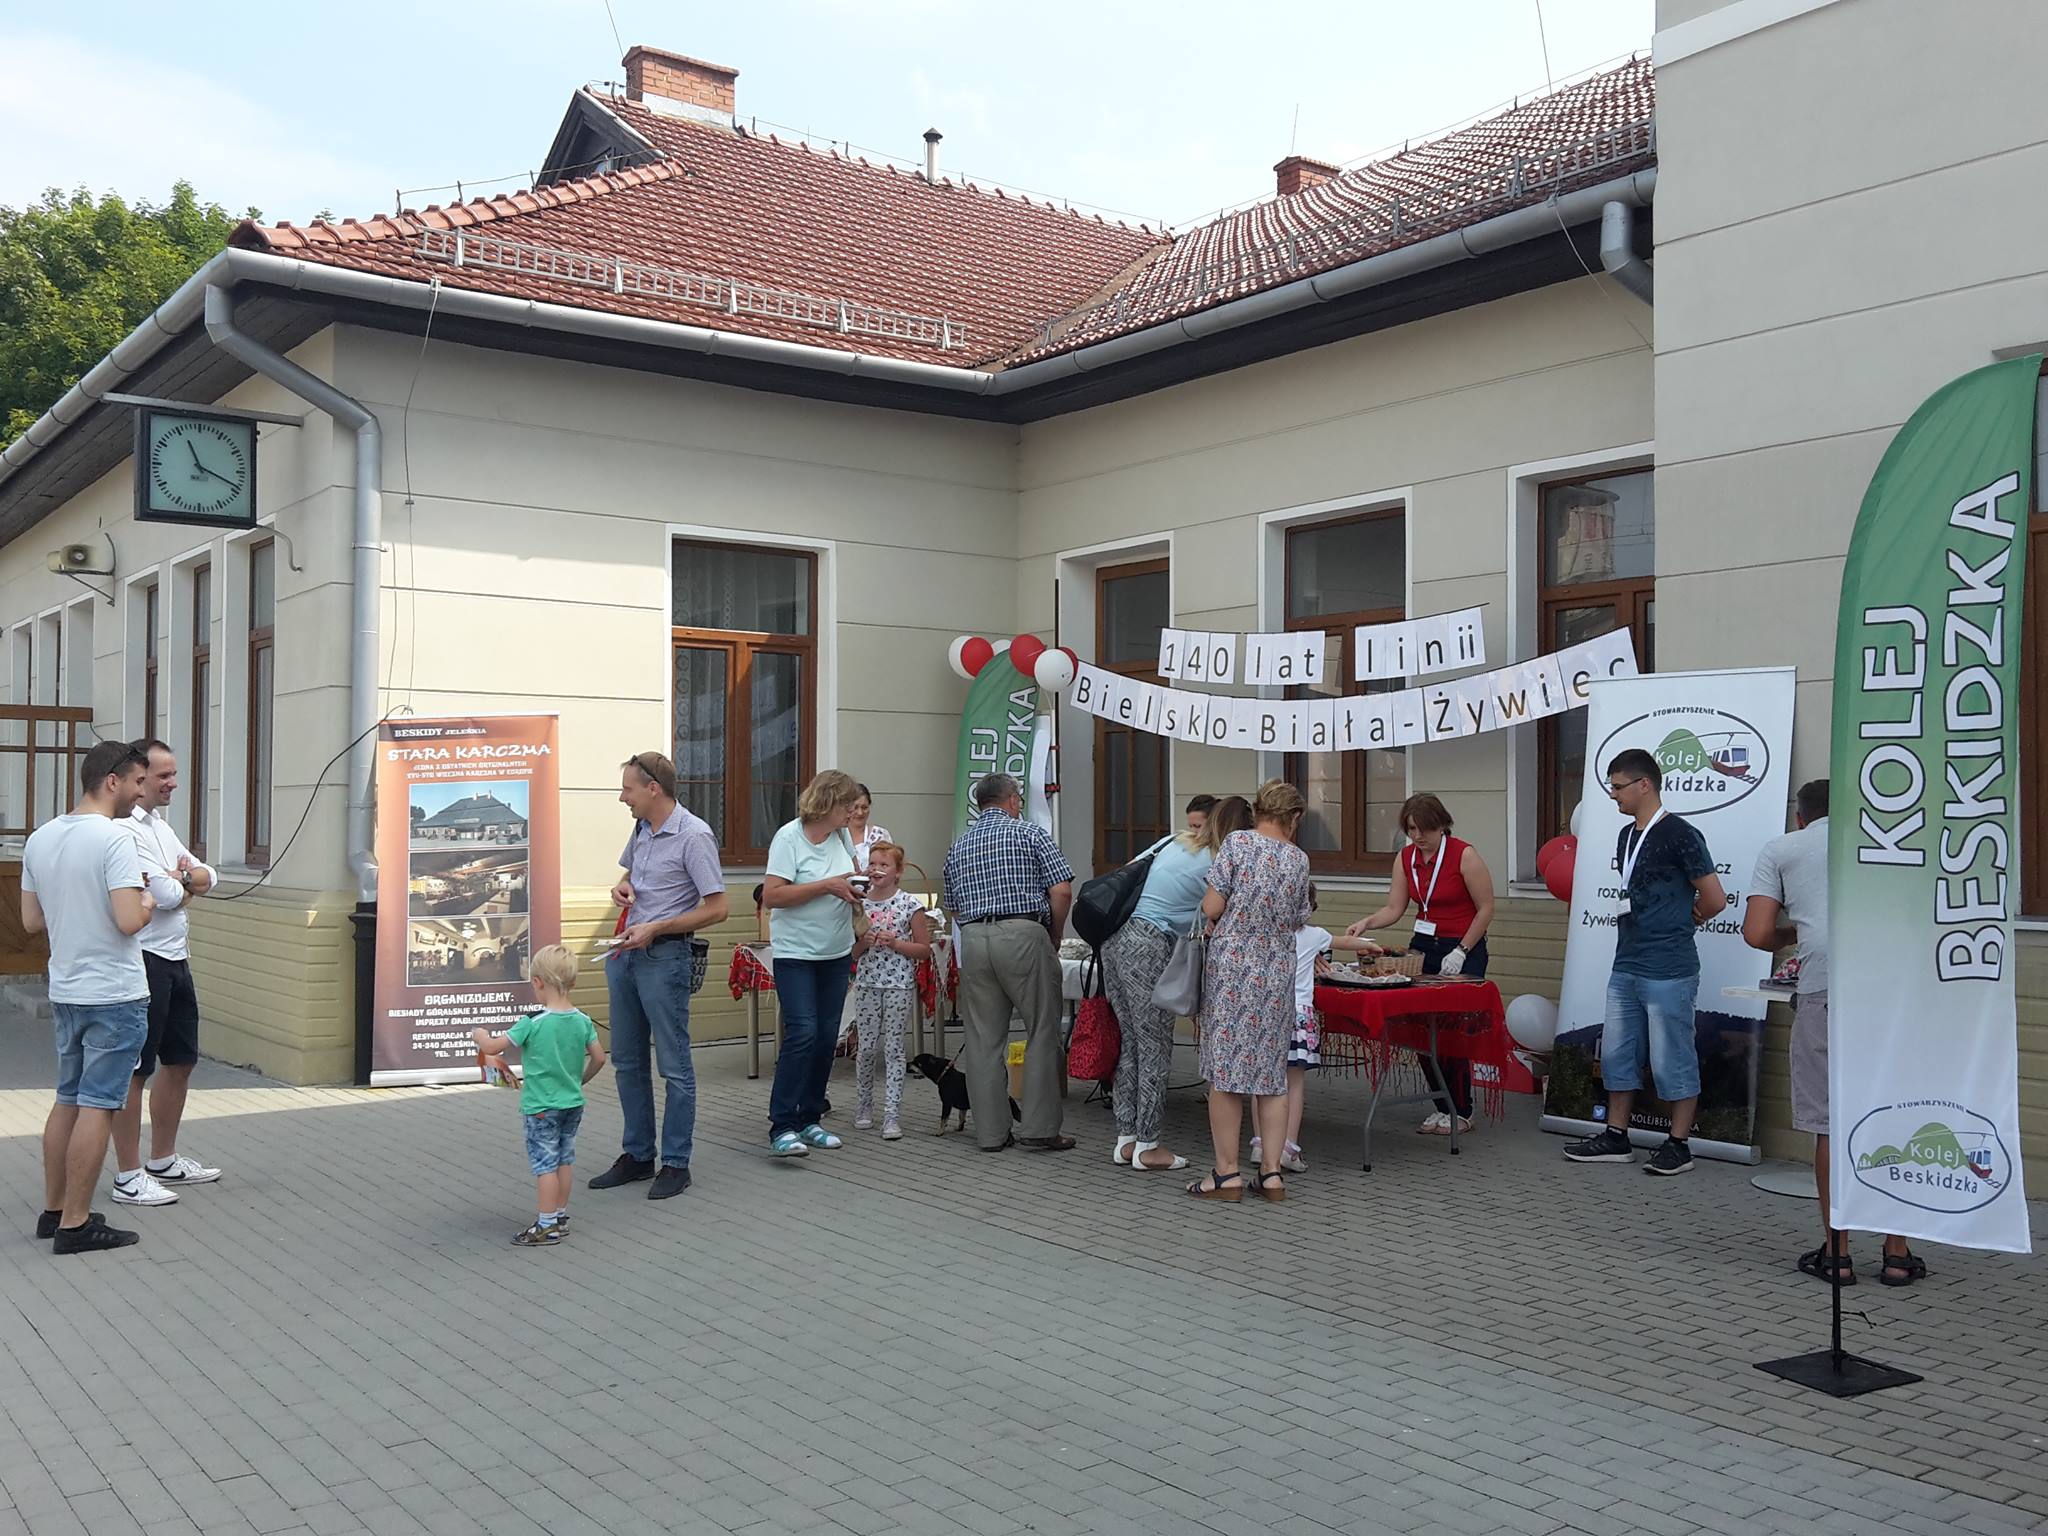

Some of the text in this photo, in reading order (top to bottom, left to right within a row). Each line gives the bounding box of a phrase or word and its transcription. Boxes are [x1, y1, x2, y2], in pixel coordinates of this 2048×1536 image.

[1164, 625, 1475, 678] 140 lat linii
[1652, 706, 1715, 718] STOWARZYSZENIE
[394, 727, 443, 738] BESKIDY
[1858, 470, 2020, 982] KOLEJ BESKIDZKA
[387, 744, 552, 761] STARA KARCZMA
[1655, 750, 1702, 769] Kolej
[1664, 776, 1727, 792] kidzka
[1910, 1142, 1960, 1168] Kolej
[1889, 1166, 1978, 1194] Beskidzka
